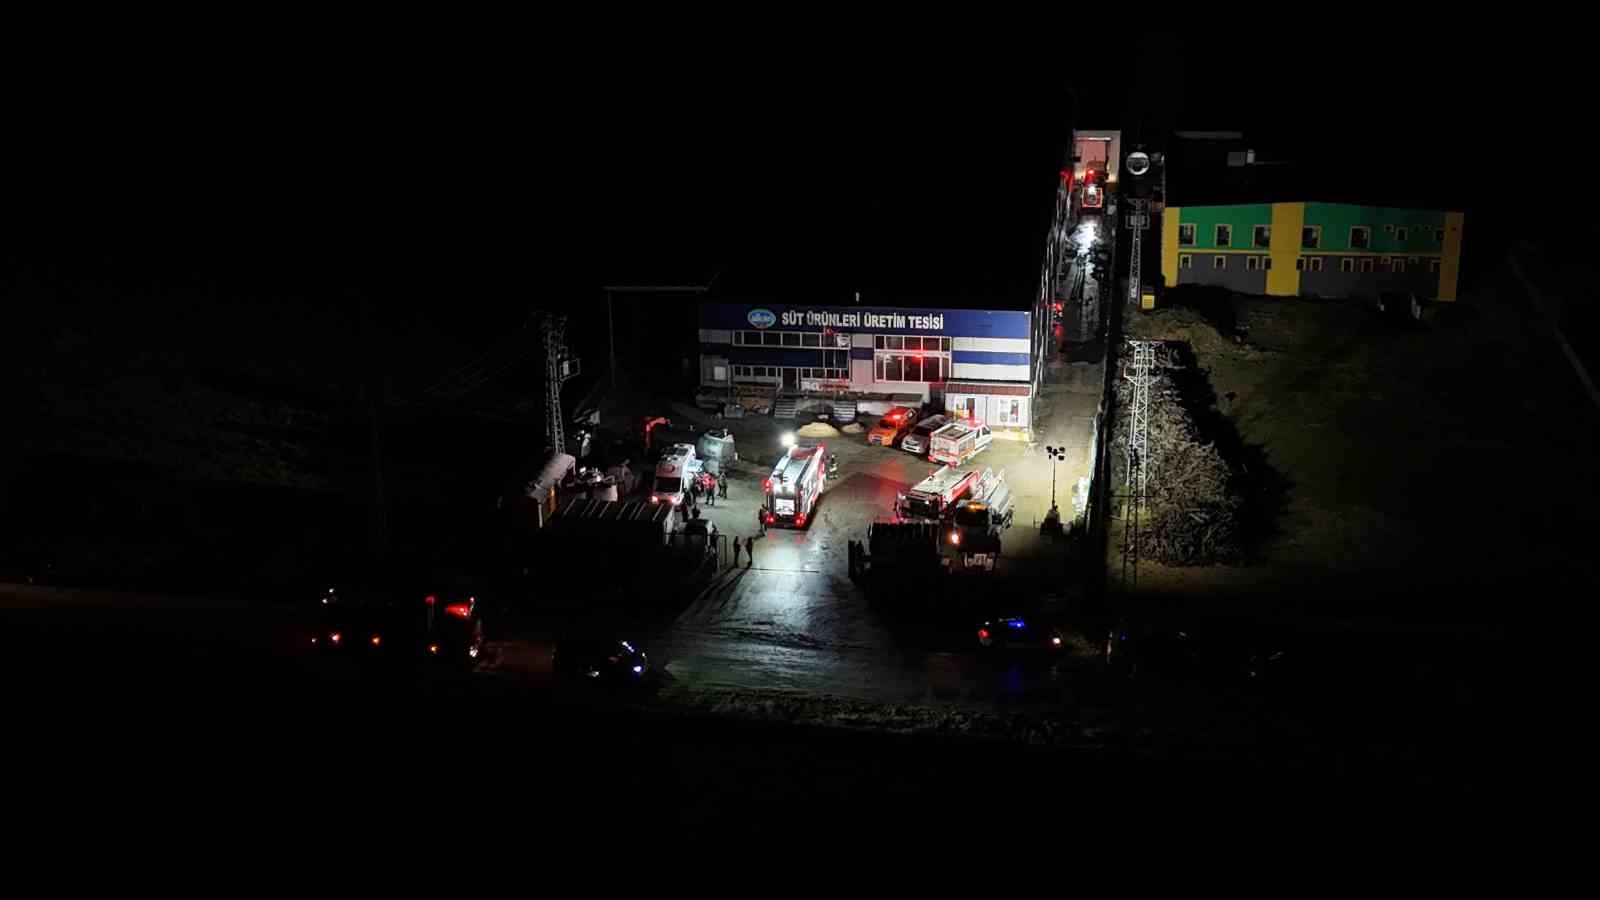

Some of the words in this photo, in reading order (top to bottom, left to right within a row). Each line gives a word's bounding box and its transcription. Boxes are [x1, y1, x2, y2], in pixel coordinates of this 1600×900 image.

[781, 310, 804, 325] SÜT
[806, 310, 860, 327] ÜRÜNLERİ
[864, 312, 906, 328] ÜRETİM
[908, 313, 944, 329] TESİSİ
